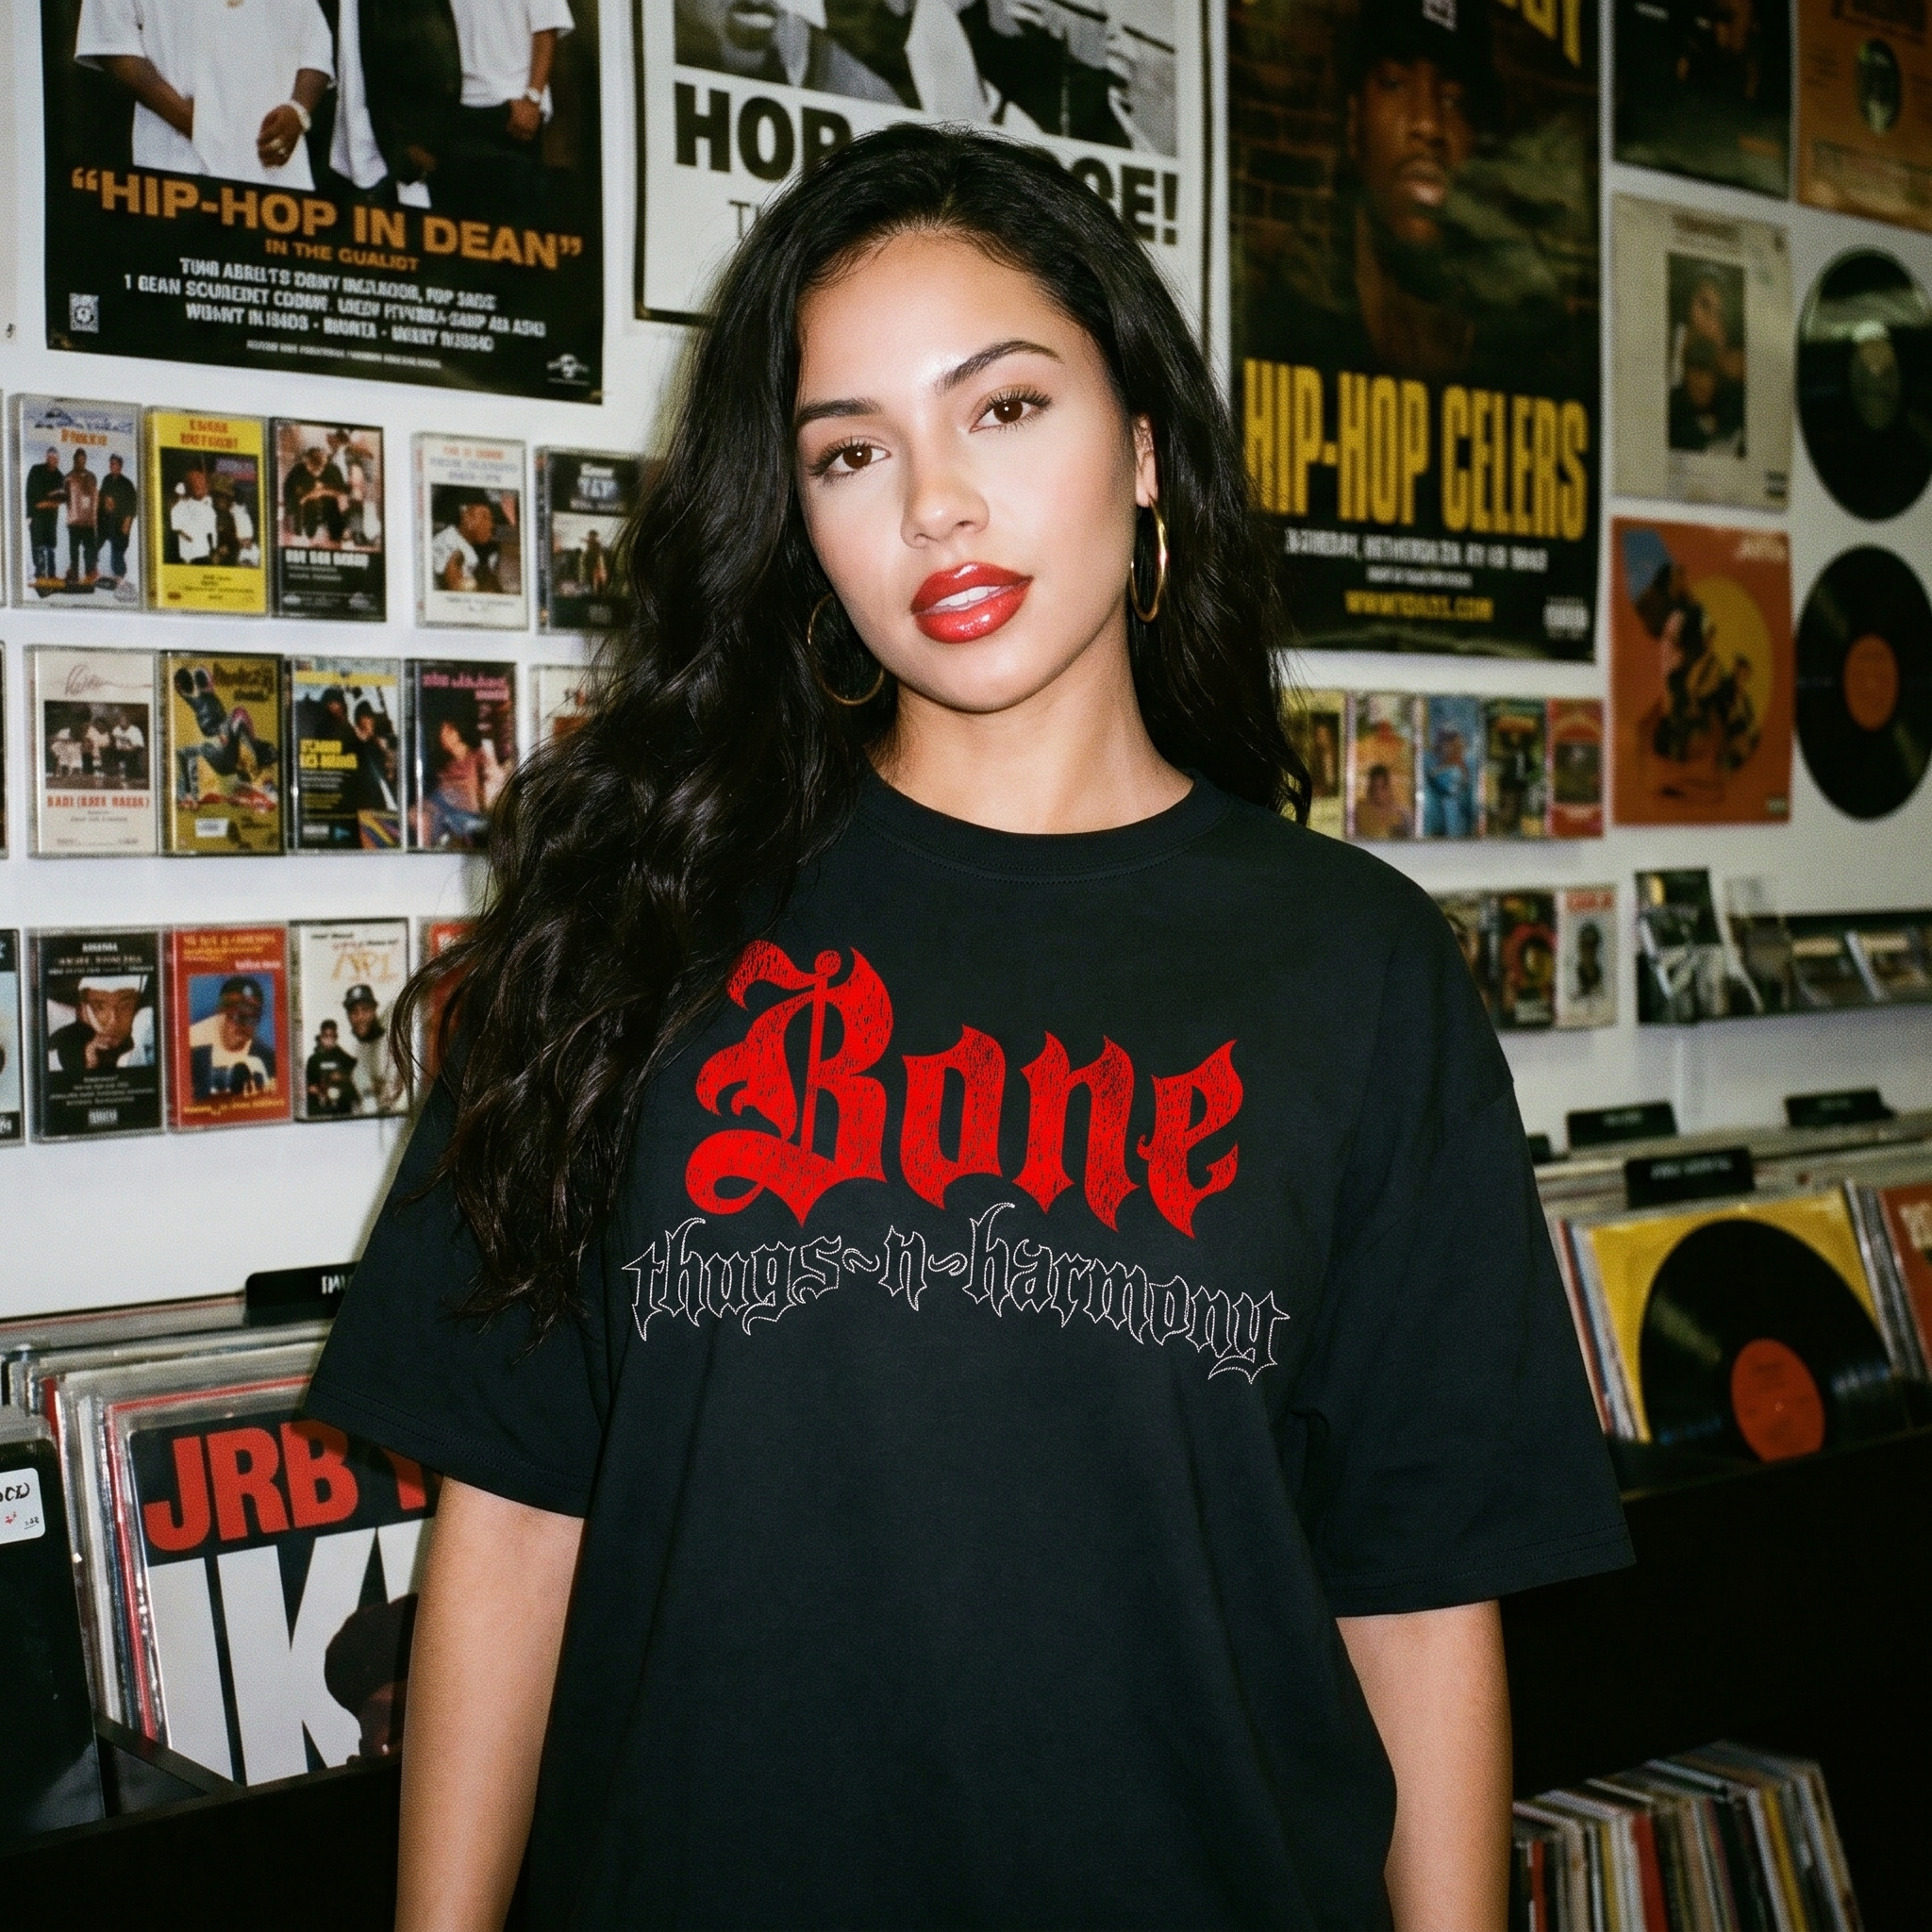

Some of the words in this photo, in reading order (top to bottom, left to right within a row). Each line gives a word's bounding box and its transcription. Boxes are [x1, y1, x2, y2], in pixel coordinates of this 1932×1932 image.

[265, 238, 289, 256] IN
[292, 241, 333, 262] THE
[353, 205, 407, 249] IN
[422, 215, 583, 270] DEAN”
[1243, 357, 1431, 527] HIP-HOP
[685, 940, 1244, 1240] Bone
